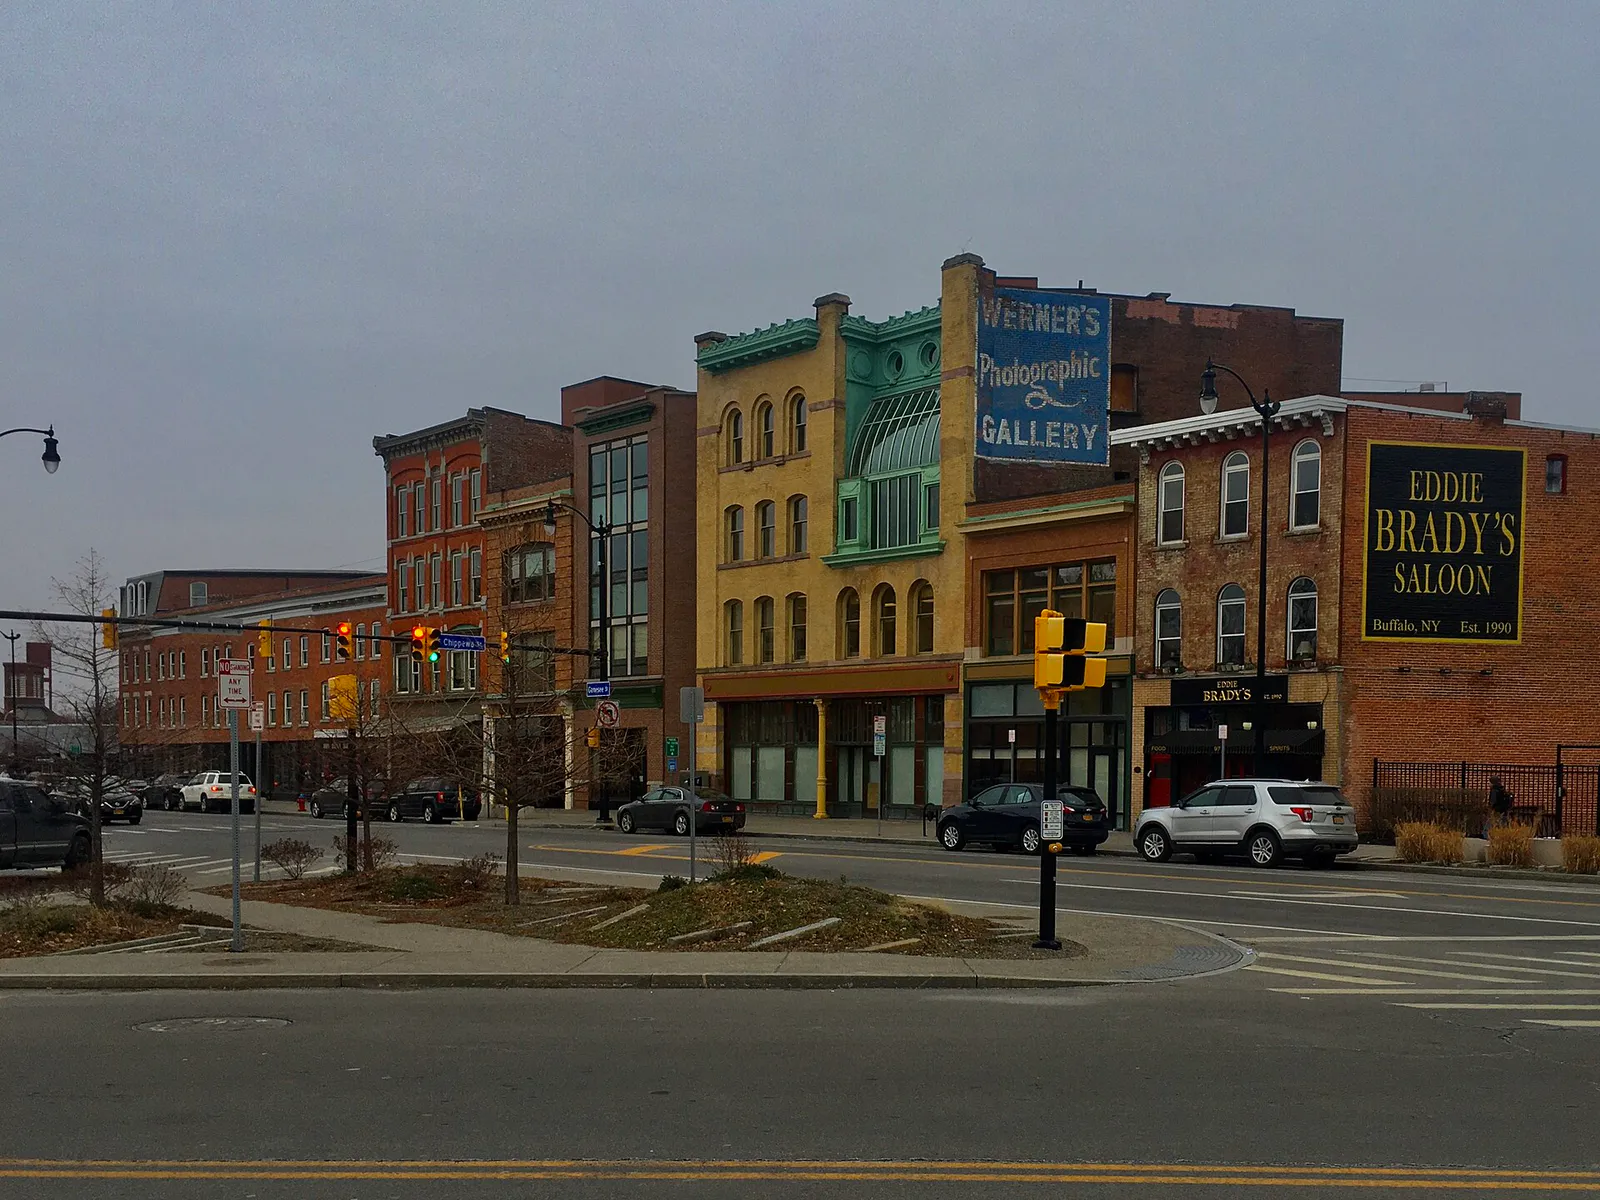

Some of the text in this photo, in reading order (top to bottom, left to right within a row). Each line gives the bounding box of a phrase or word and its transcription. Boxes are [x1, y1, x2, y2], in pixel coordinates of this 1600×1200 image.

[982, 298, 1101, 337] WERNER'S
[979, 350, 1101, 390] Photographic
[982, 415, 1098, 450] GALLERY
[1409, 470, 1484, 503] EDDIE
[1374, 508, 1515, 557] BRADY'S
[1394, 562, 1493, 596] SALOON
[443, 638, 475, 648] Chippewa
[1373, 619, 1512, 635] Buffalo, NY Est. 1990
[220, 661, 230, 672] NO
[1203, 688, 1252, 702] BRADY'S
[1217, 681, 1238, 689] EDDIE
